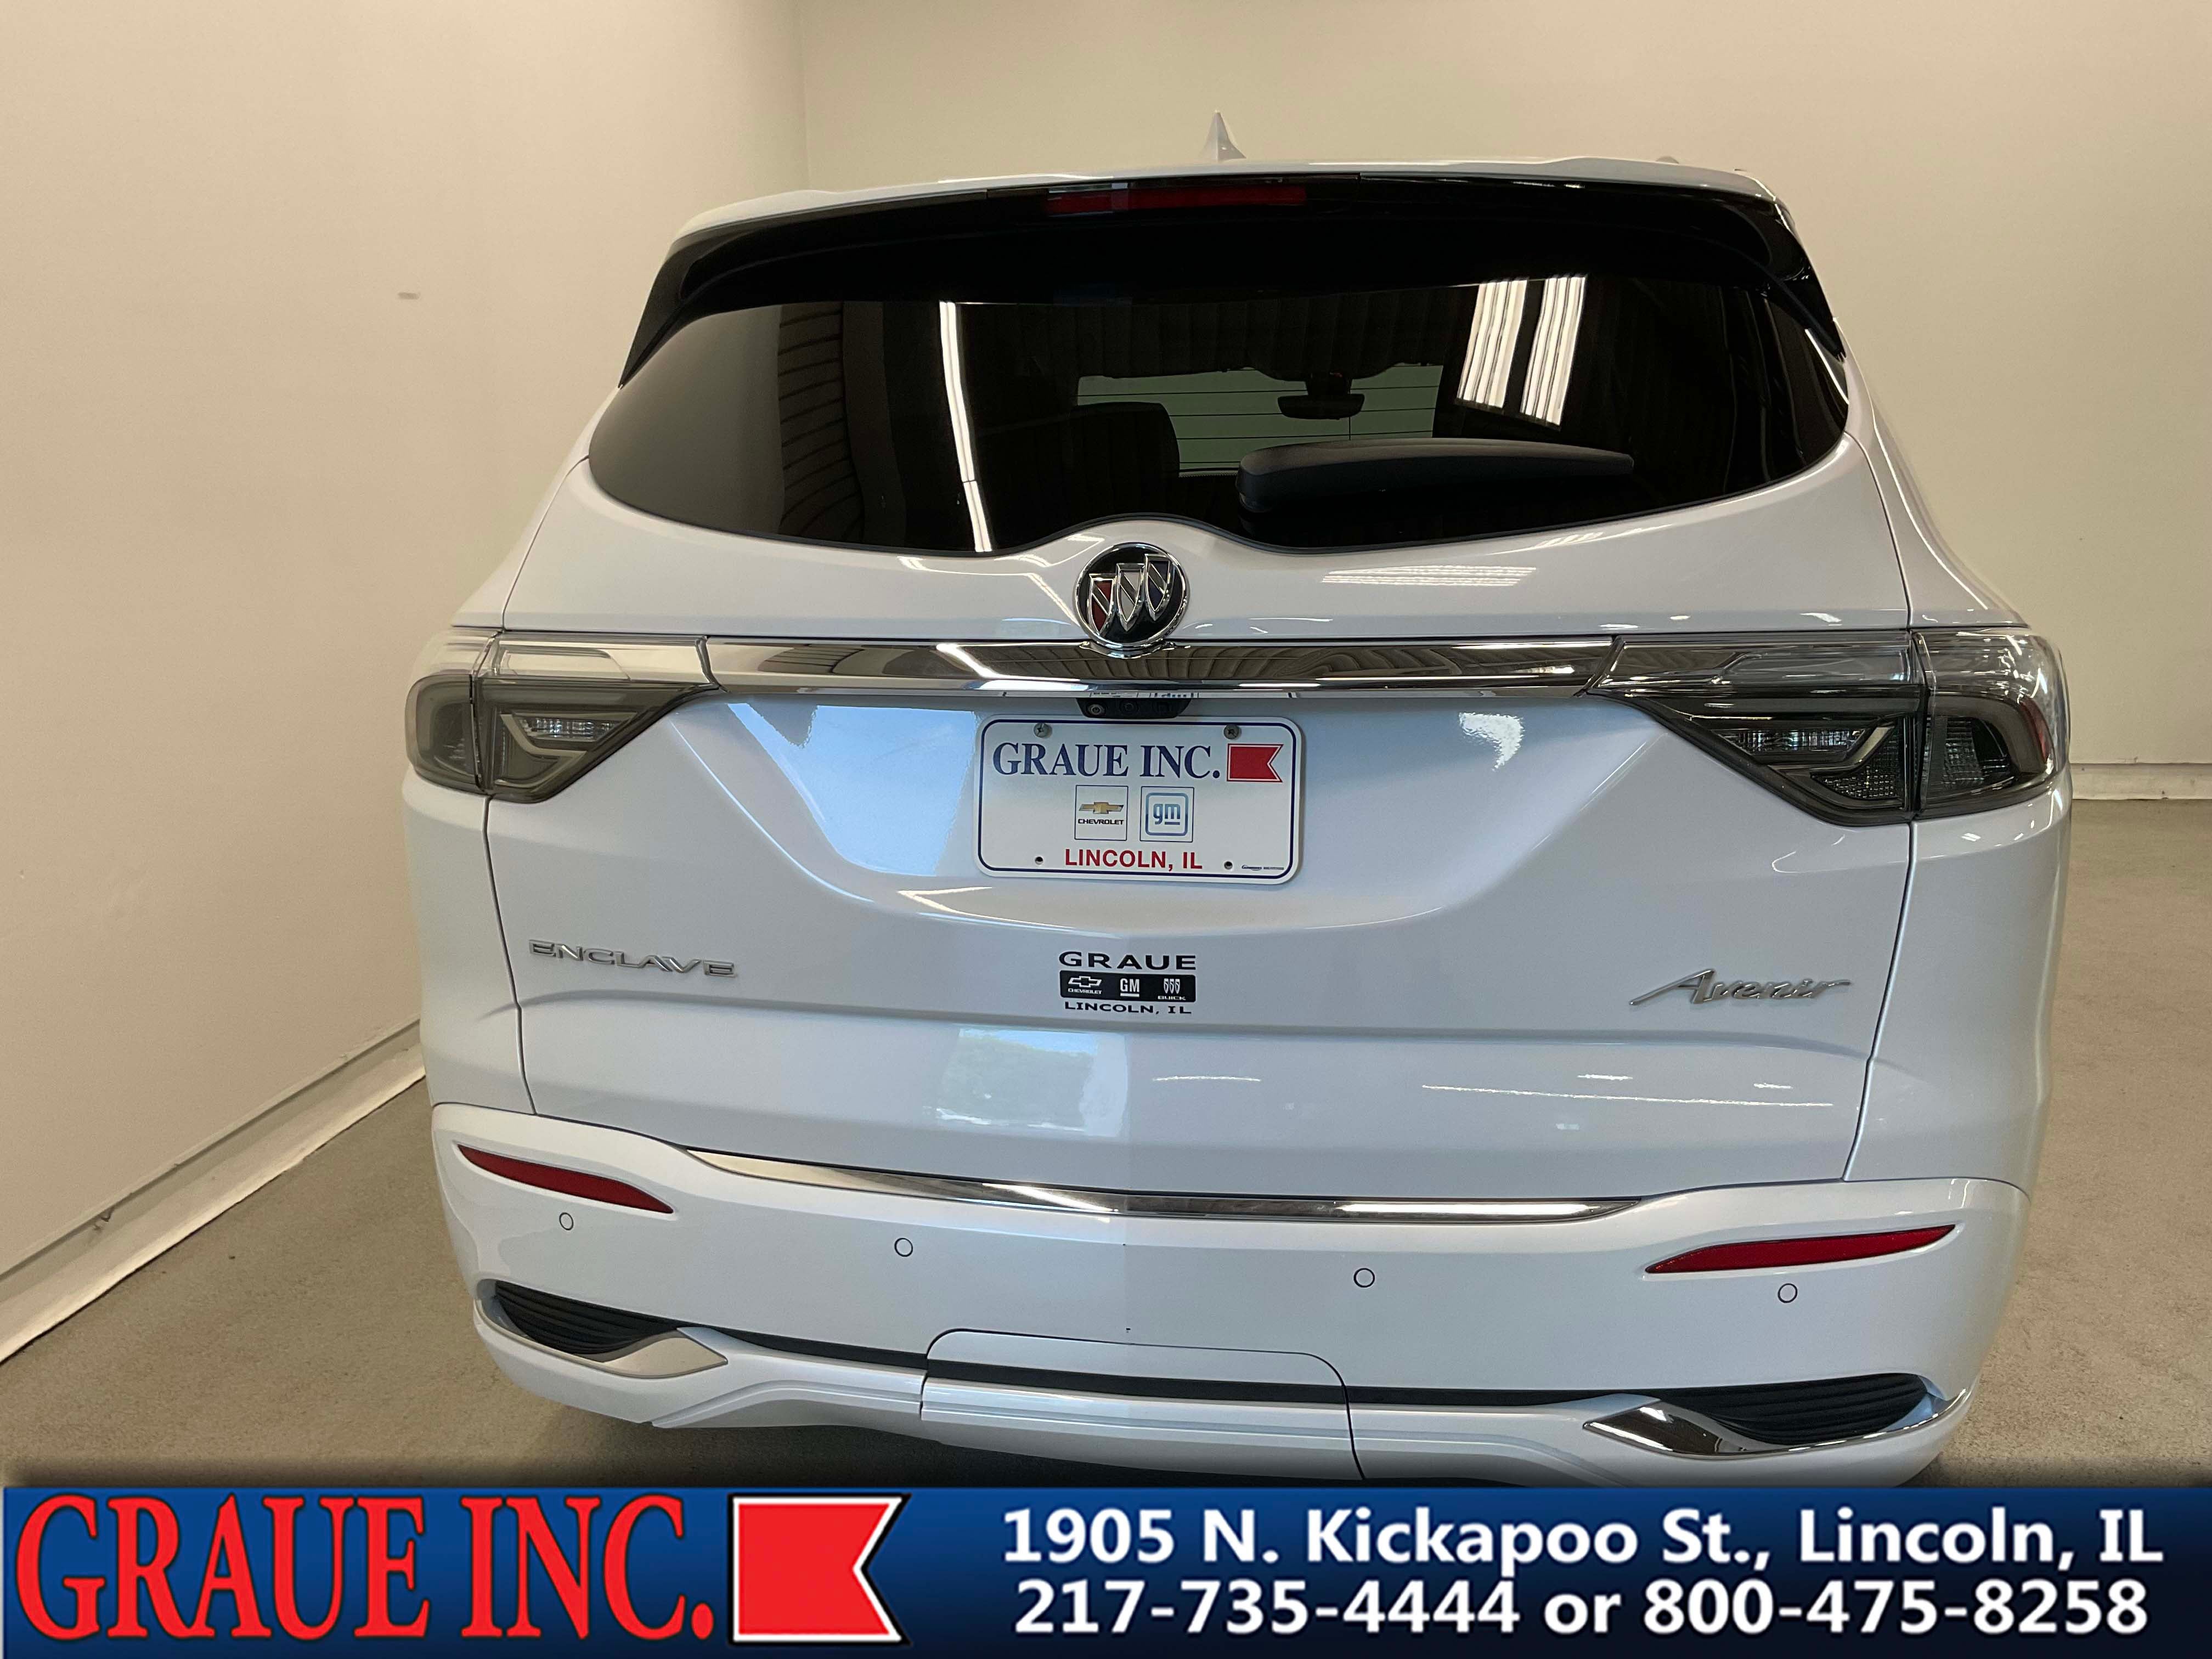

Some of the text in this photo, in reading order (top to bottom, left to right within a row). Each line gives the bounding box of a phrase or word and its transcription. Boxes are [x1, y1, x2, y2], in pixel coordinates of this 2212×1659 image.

[992, 742, 1220, 779] GRAUE INC.
[1153, 803, 1181, 826] gm
[1065, 849, 1203, 872] LINCOLN, IL
[529, 939, 737, 978] ENCLAVE
[1059, 951, 1196, 970] GRAUE
[1120, 978, 1140, 993] GM
[1628, 968, 1851, 1005] Avenir
[1064, 1001, 1192, 1015] LINCOLN, IL
